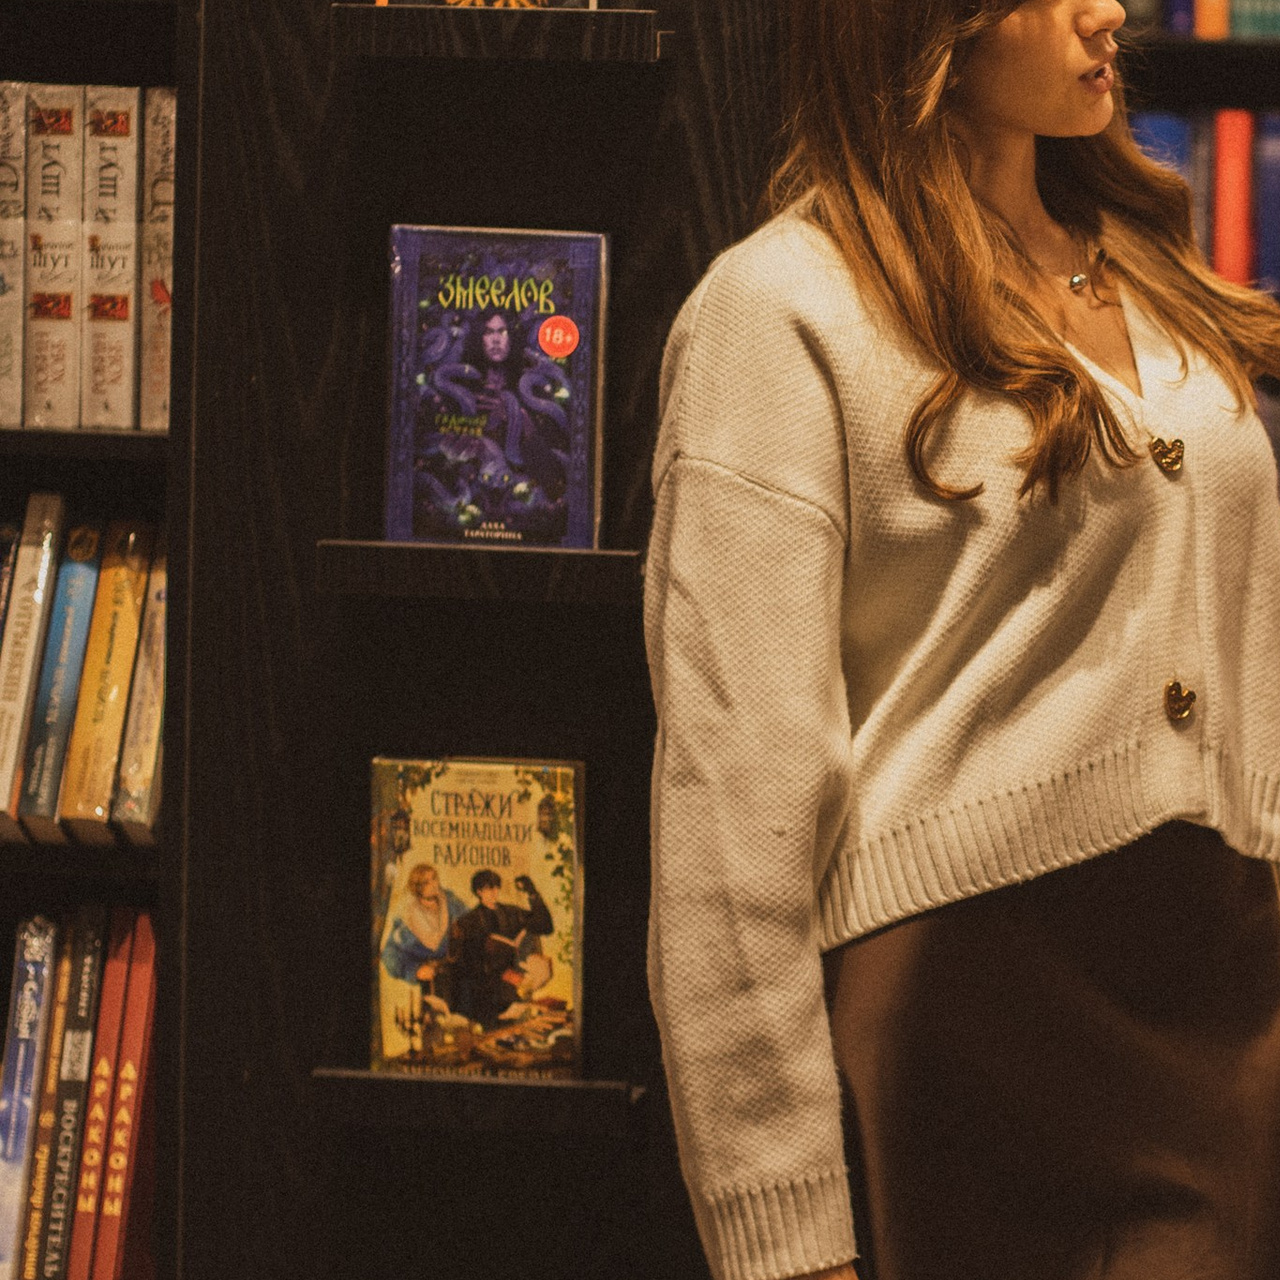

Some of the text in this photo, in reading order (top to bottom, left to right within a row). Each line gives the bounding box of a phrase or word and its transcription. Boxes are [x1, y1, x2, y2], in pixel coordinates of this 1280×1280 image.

[41, 140, 66, 198] ШУТ
[99, 141, 124, 198] ШУТ
[438, 273, 556, 315] ЗМЕЕЛОВ
[545, 327, 573, 345] 18+
[430, 789, 516, 820] СТРАЖИ
[412, 821, 534, 844] ВОСЕМНАДЦАТИ
[433, 844, 512, 867] РАЙОНОВ
[44, 1098, 78, 1278] ВОСКРЕСИТЕЛЬ
